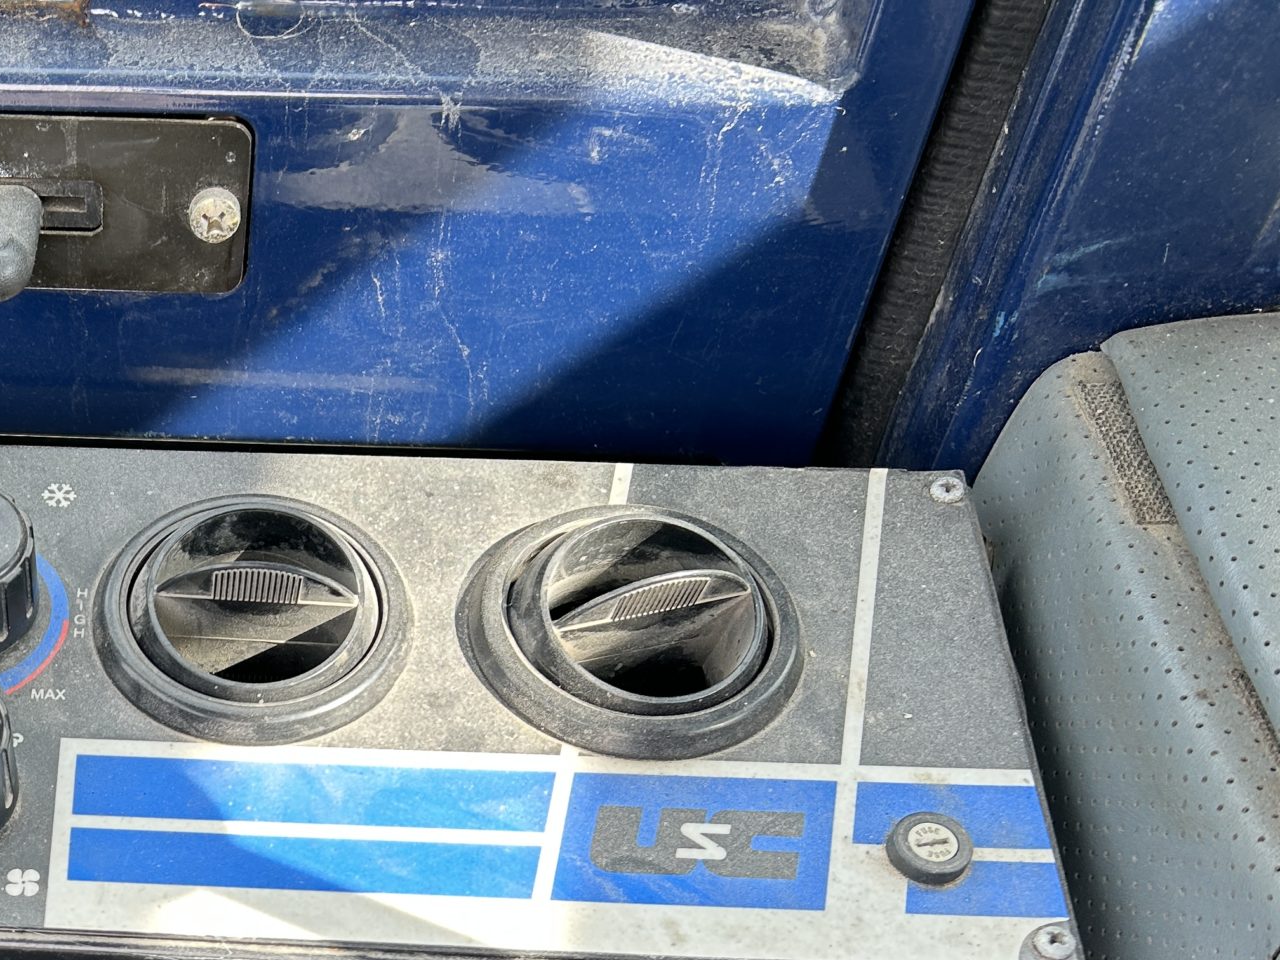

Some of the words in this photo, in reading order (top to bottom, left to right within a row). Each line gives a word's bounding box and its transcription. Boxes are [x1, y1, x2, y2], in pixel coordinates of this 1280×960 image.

[73, 587, 89, 638] HIGH
[30, 687, 66, 701] MAX
[915, 826, 941, 837] FUSE
